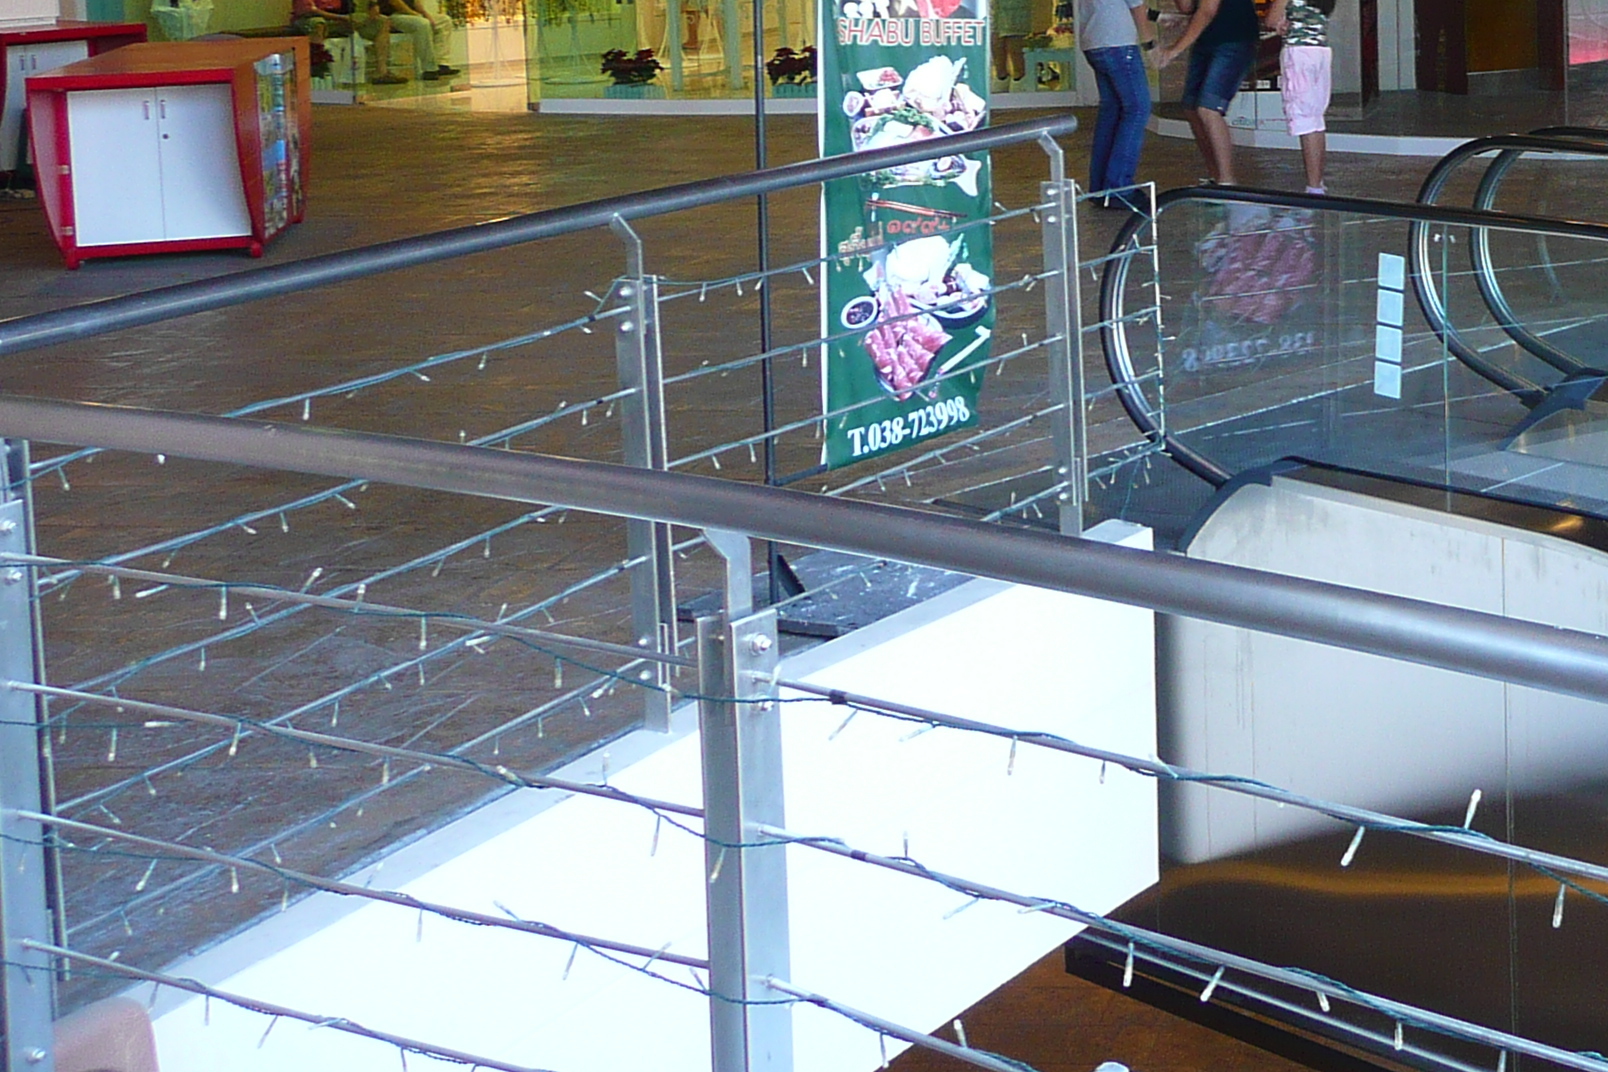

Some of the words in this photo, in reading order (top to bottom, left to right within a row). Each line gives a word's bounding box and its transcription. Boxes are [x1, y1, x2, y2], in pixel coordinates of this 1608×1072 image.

[837, 16, 915, 46] SHABU
[919, 19, 985, 46] BUFFET
[847, 395, 970, 457] T.038-723998
